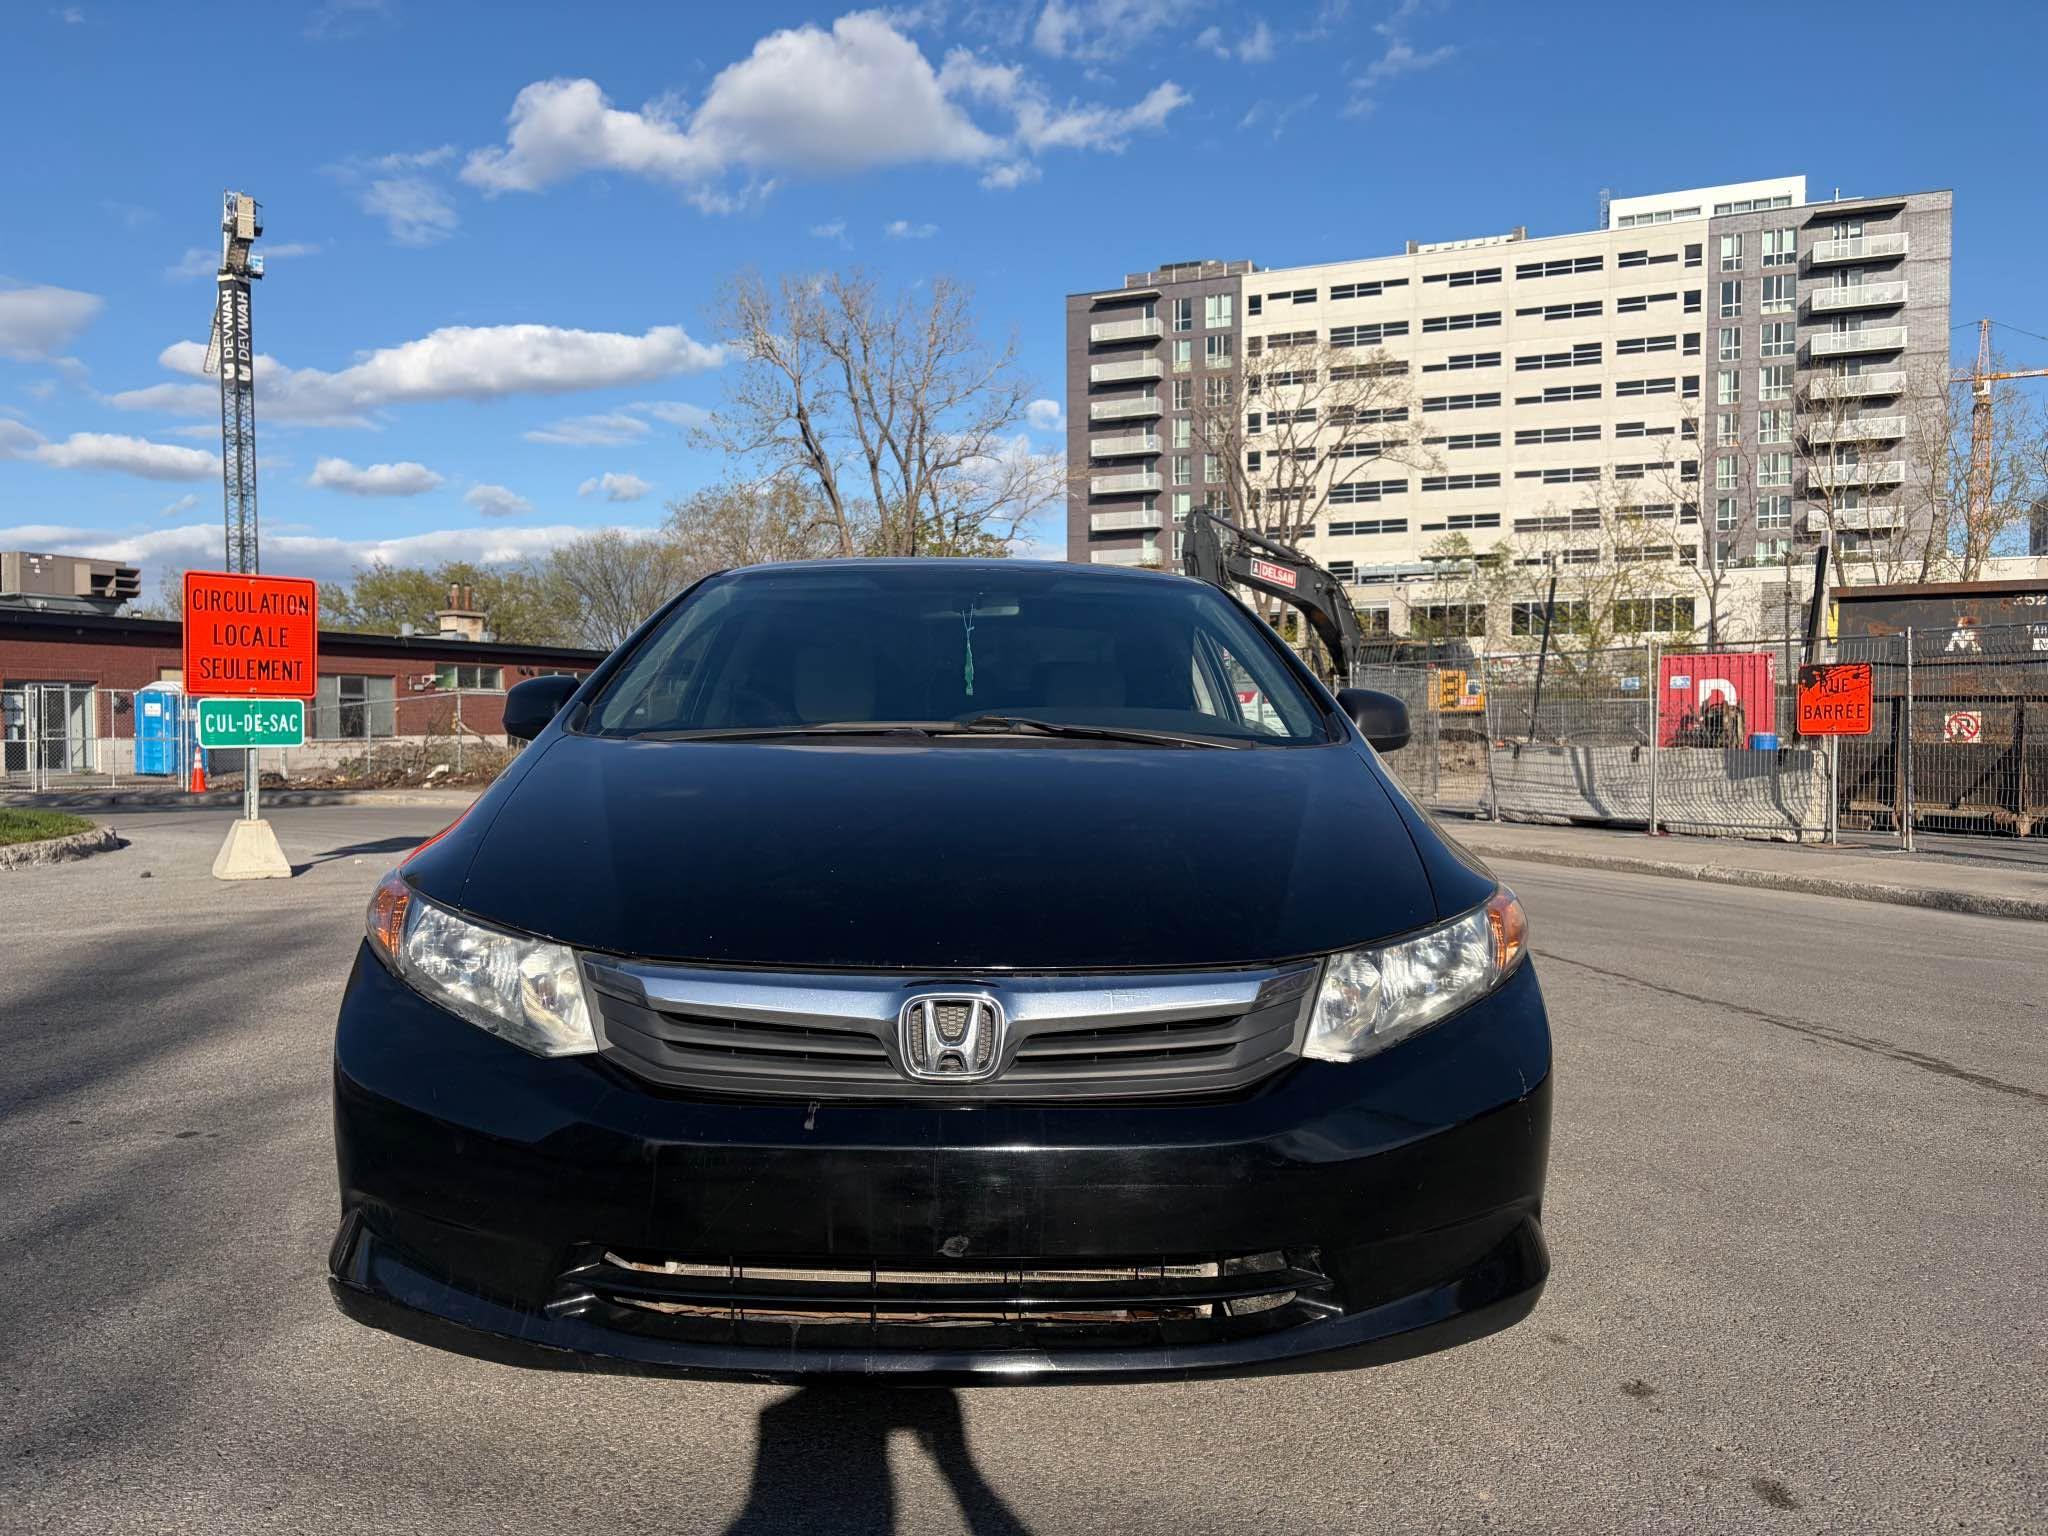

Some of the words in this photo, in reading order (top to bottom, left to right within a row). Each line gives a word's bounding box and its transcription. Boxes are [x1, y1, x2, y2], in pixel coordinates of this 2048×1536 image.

[222, 288, 235, 359] DEVWAH
[236, 290, 250, 361] DEVWAH
[1262, 564, 1294, 585] DELSAN
[192, 588, 309, 617] CIRCULATION
[213, 623, 289, 648] LOCALE
[200, 657, 303, 682] SEULEMENT
[1819, 677, 1850, 694] RUE
[205, 713, 299, 733] CUL-DE-SAC
[1803, 701, 1866, 720] BARRÉE
